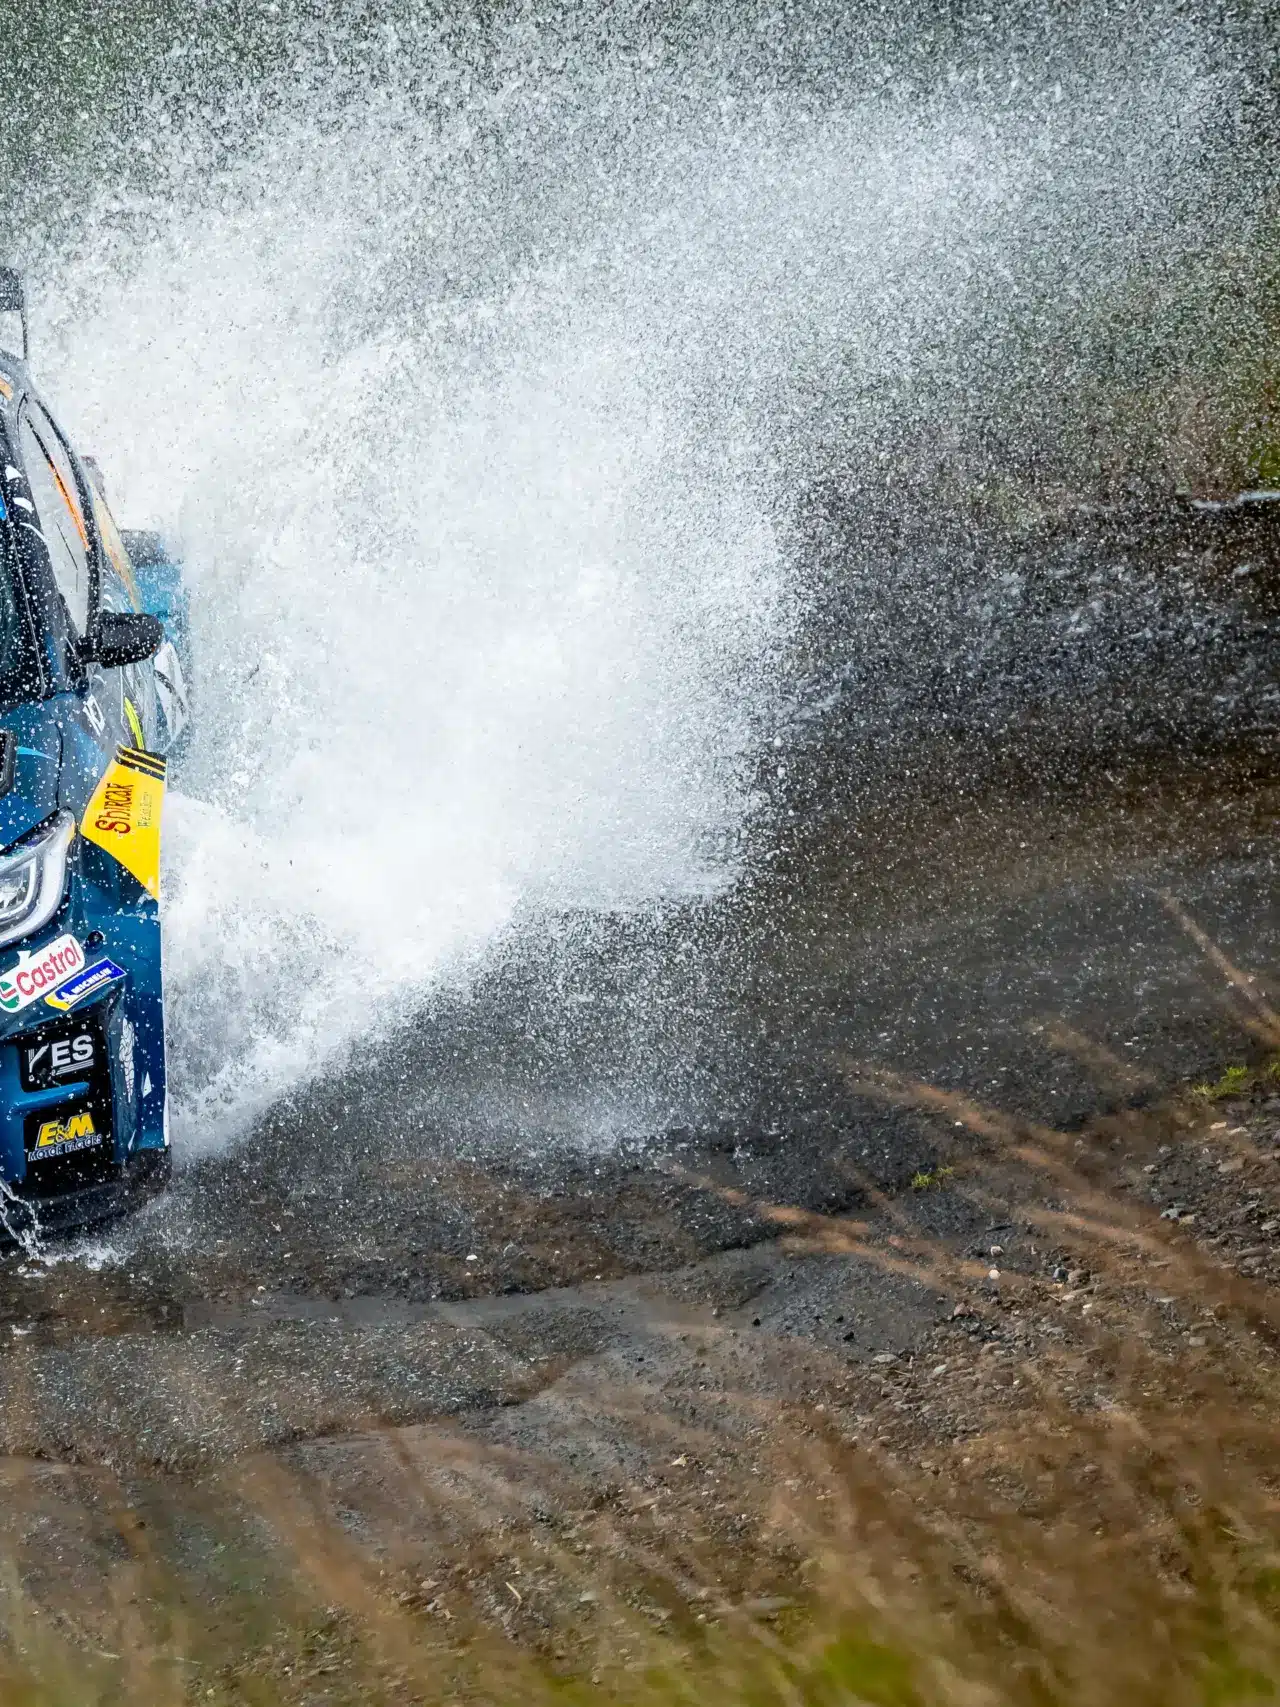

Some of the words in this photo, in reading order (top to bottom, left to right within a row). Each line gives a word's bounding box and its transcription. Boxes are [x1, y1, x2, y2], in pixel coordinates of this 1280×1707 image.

[15, 939, 82, 996] Castrol
[70, 967, 113, 992] MICHELIN
[35, 1112, 97, 1149] E&M
[27, 1141, 64, 1162] MOTOR
